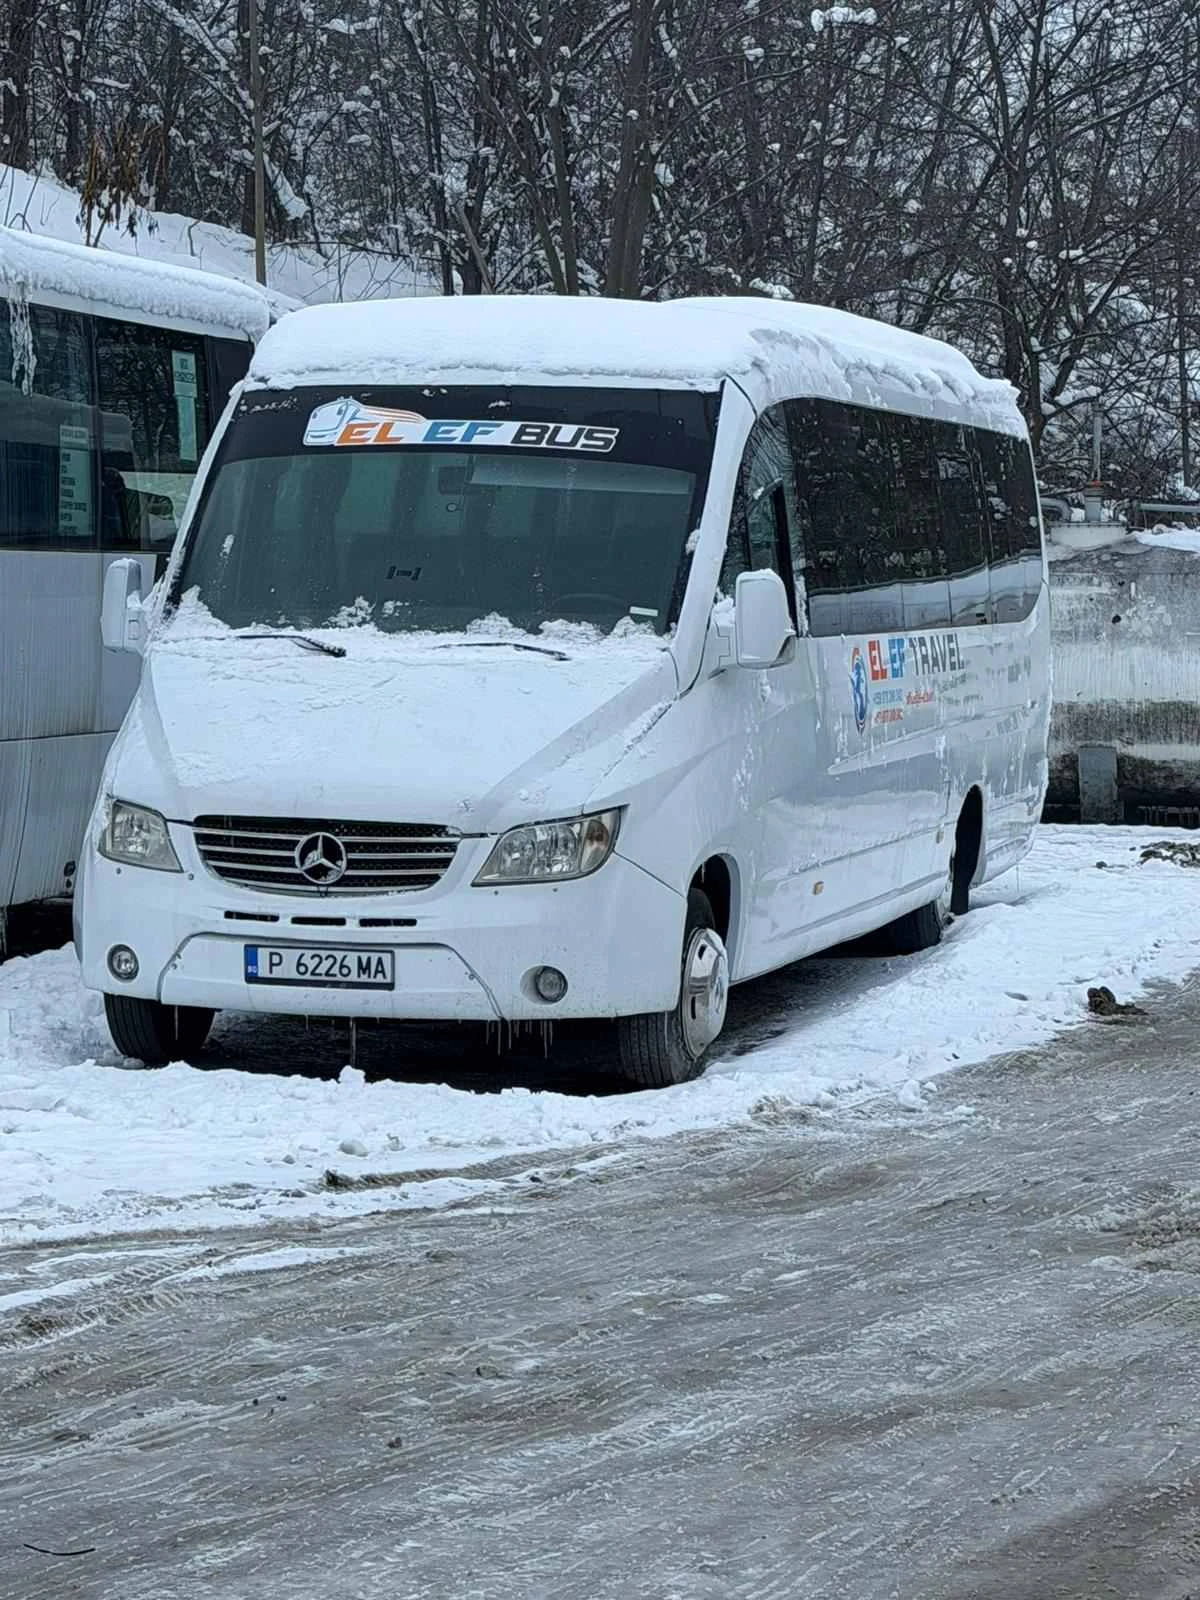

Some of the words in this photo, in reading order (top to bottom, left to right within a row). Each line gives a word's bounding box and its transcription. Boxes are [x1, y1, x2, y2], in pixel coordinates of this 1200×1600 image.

[337, 422, 404, 443] EL
[422, 421, 504, 442] EF
[510, 423, 618, 449] BUS
[868, 639, 887, 680] EL
[888, 638, 905, 679] EF
[908, 633, 964, 676] TRAVEL
[269, 952, 283, 974] P
[296, 953, 351, 977] 6226
[357, 955, 387, 979] MA
